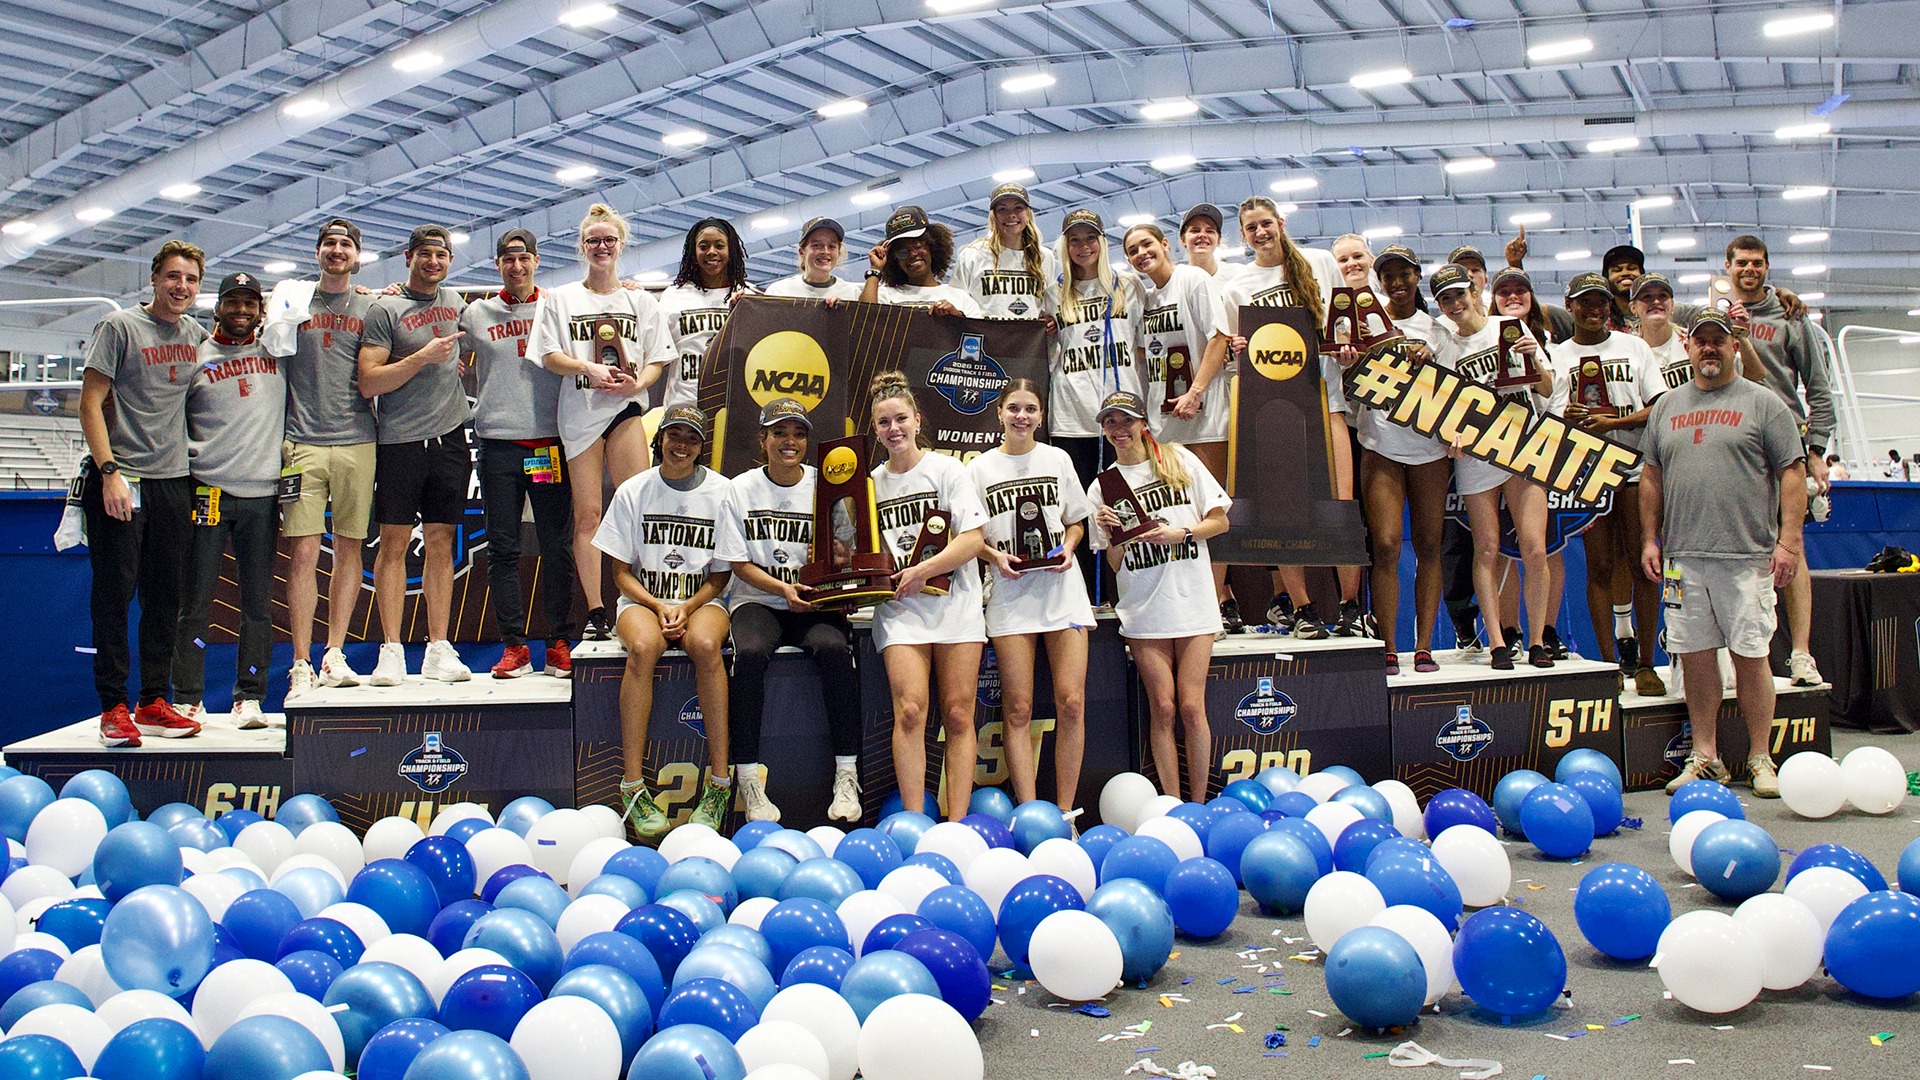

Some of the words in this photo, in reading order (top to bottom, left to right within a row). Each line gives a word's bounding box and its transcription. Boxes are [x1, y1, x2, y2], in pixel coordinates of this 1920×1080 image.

[487, 319, 534, 342] TRADIT
[569, 319, 638, 343] NATNAL
[142, 344, 197, 366] TRADITION
[1255, 350, 1303, 367] NCAA
[203, 357, 277, 385] TRADITION
[752, 369, 825, 399] NCAA
[1352, 352, 1637, 502] #NCAATF
[1670, 409, 1743, 431] TRADITION
[641, 522, 715, 550] NATIONAL
[744, 518, 813, 544] NATIONA
[1237, 706, 1295, 717] CHAMPIONSHIPS
[1545, 698, 1612, 748] 5TH
[1438, 733, 1492, 745] CHAMPIONSHIPS
[1771, 717, 1816, 754] 7TH
[400, 763, 466, 774] CHAMPIONSHIPS
